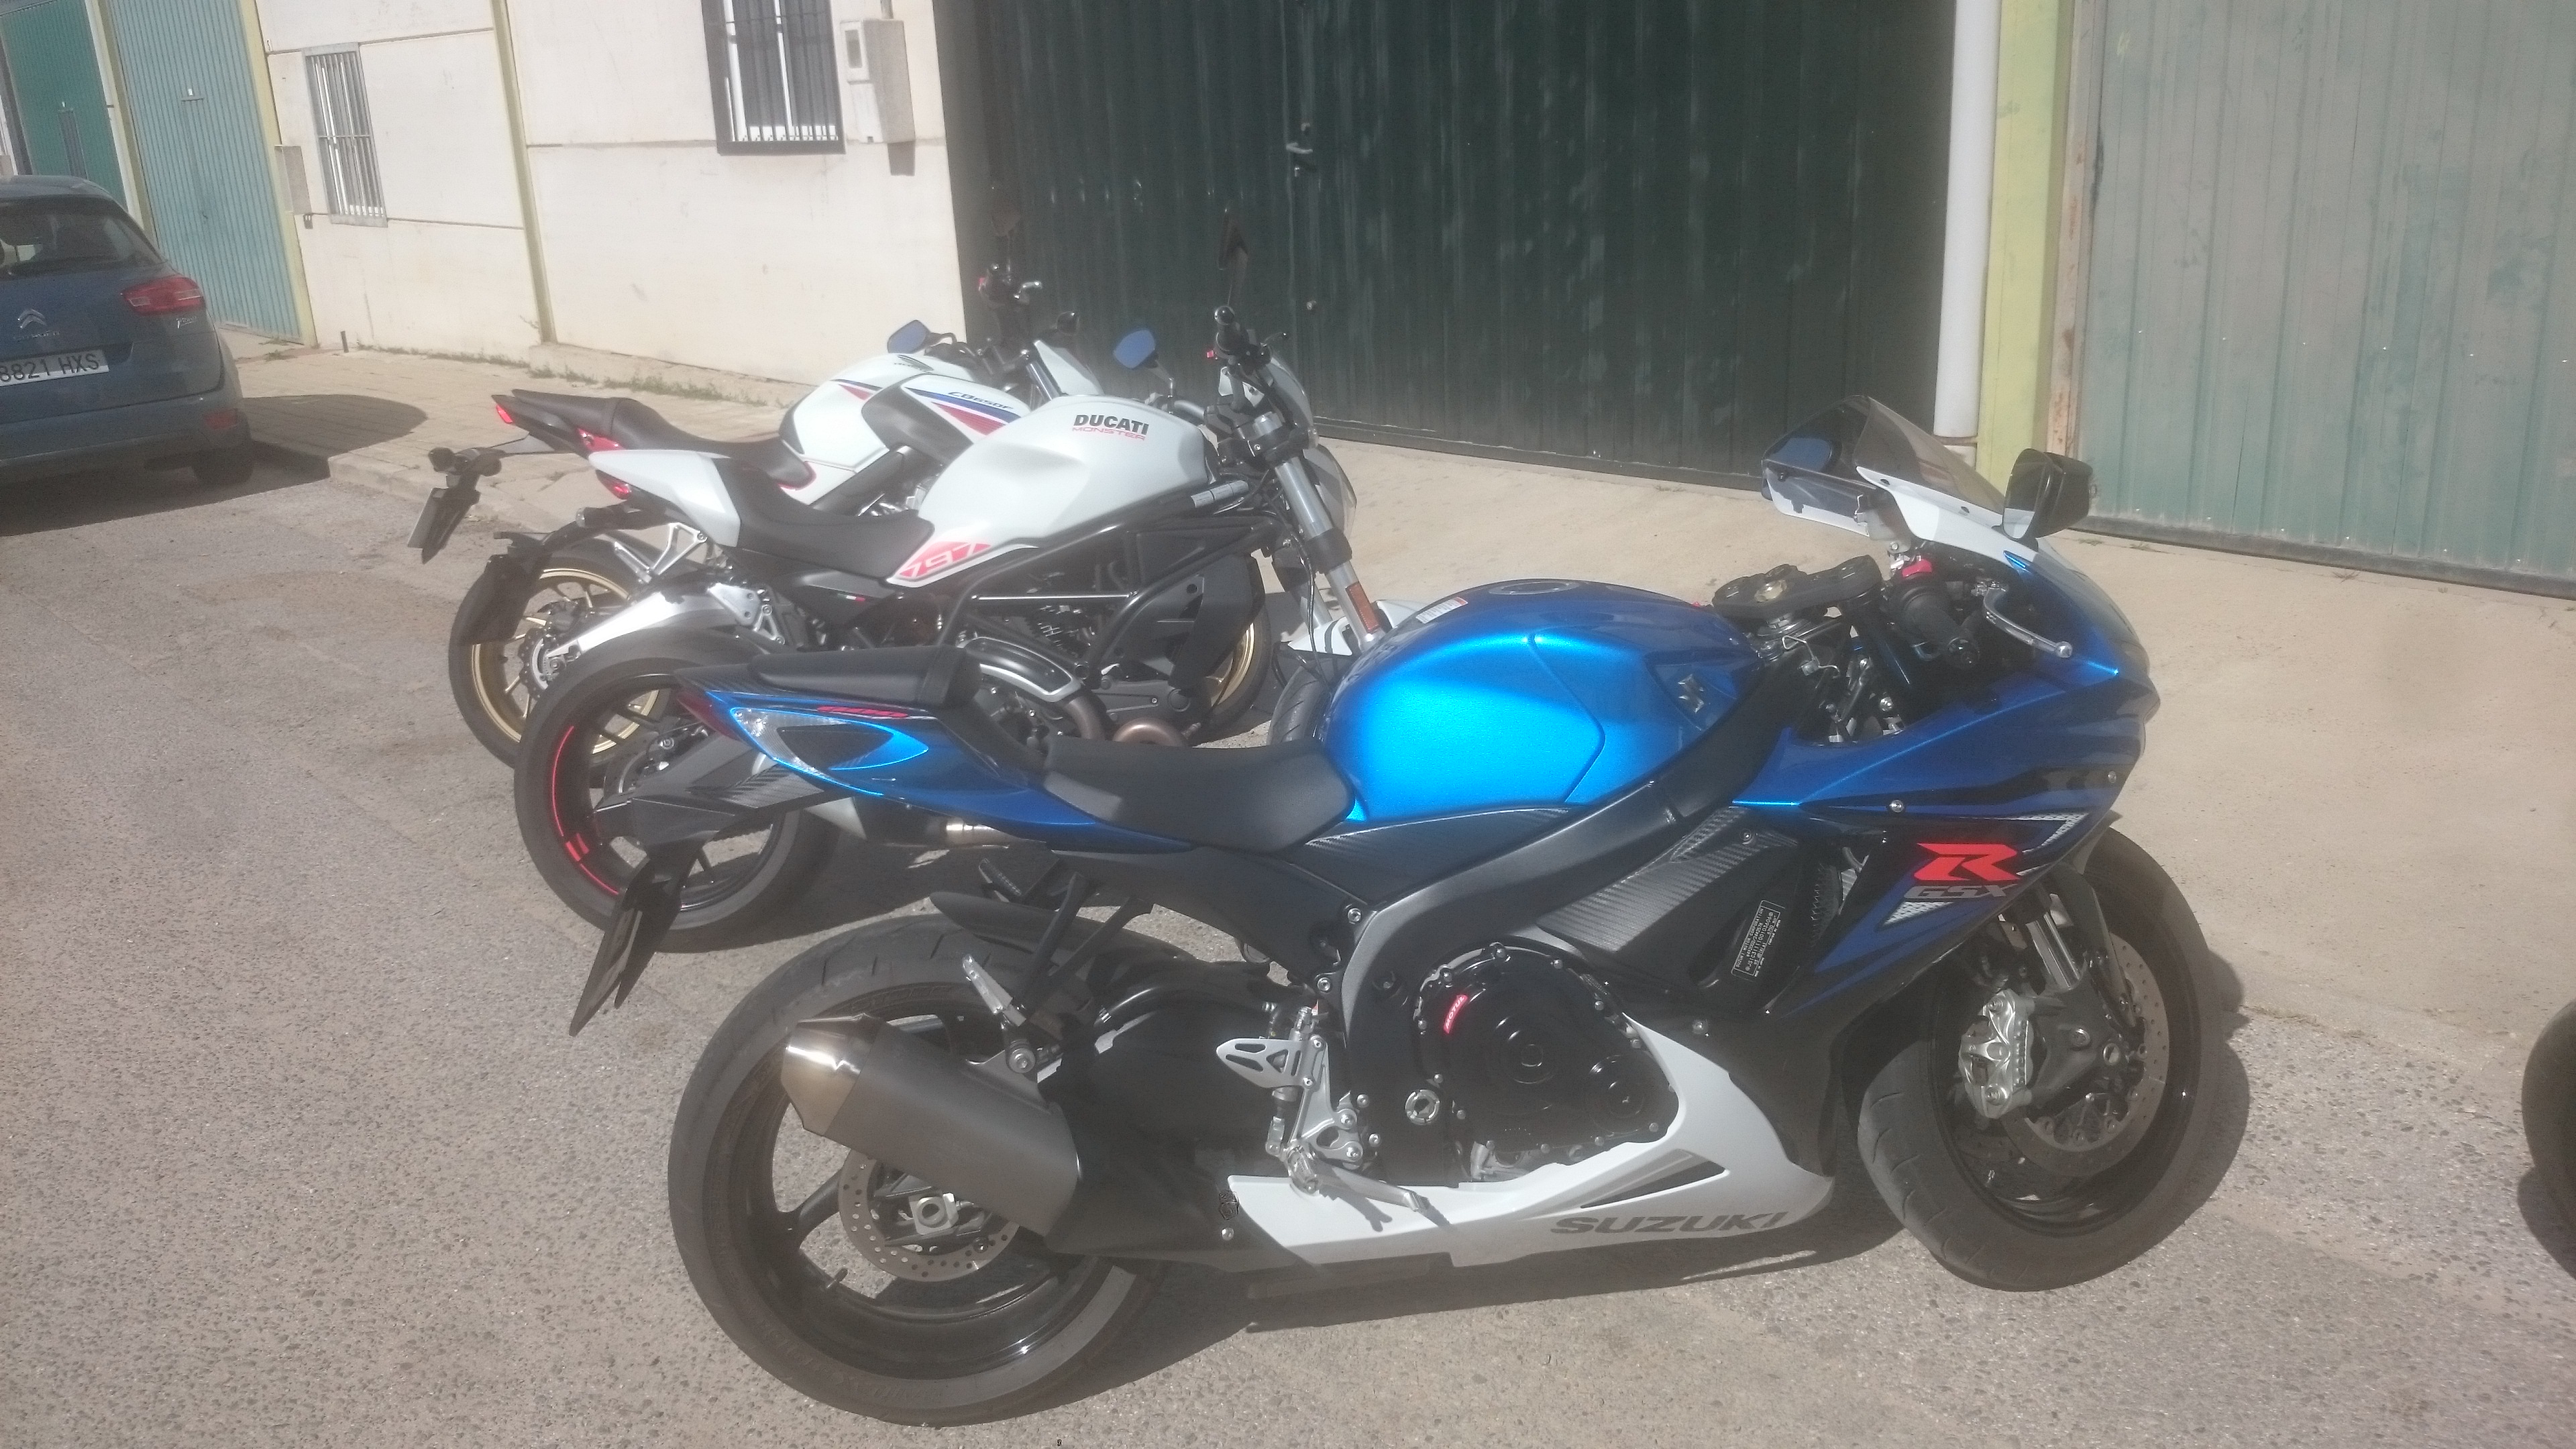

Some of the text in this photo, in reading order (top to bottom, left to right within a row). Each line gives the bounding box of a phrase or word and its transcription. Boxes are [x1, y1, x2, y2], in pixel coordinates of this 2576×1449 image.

[0, 354, 99, 382] 8821 HXS
[1072, 427, 1146, 441] MONSTER
[1073, 415, 1149, 435] DUCATI
[903, 542, 978, 578] 797
[1914, 843, 2021, 881] R
[1904, 883, 2018, 899] GSX
[1735, 953, 1745, 968] SUZUKI
[1446, 996, 1465, 1030] MOTUL
[1550, 1211, 1789, 1234] SUZUKI
